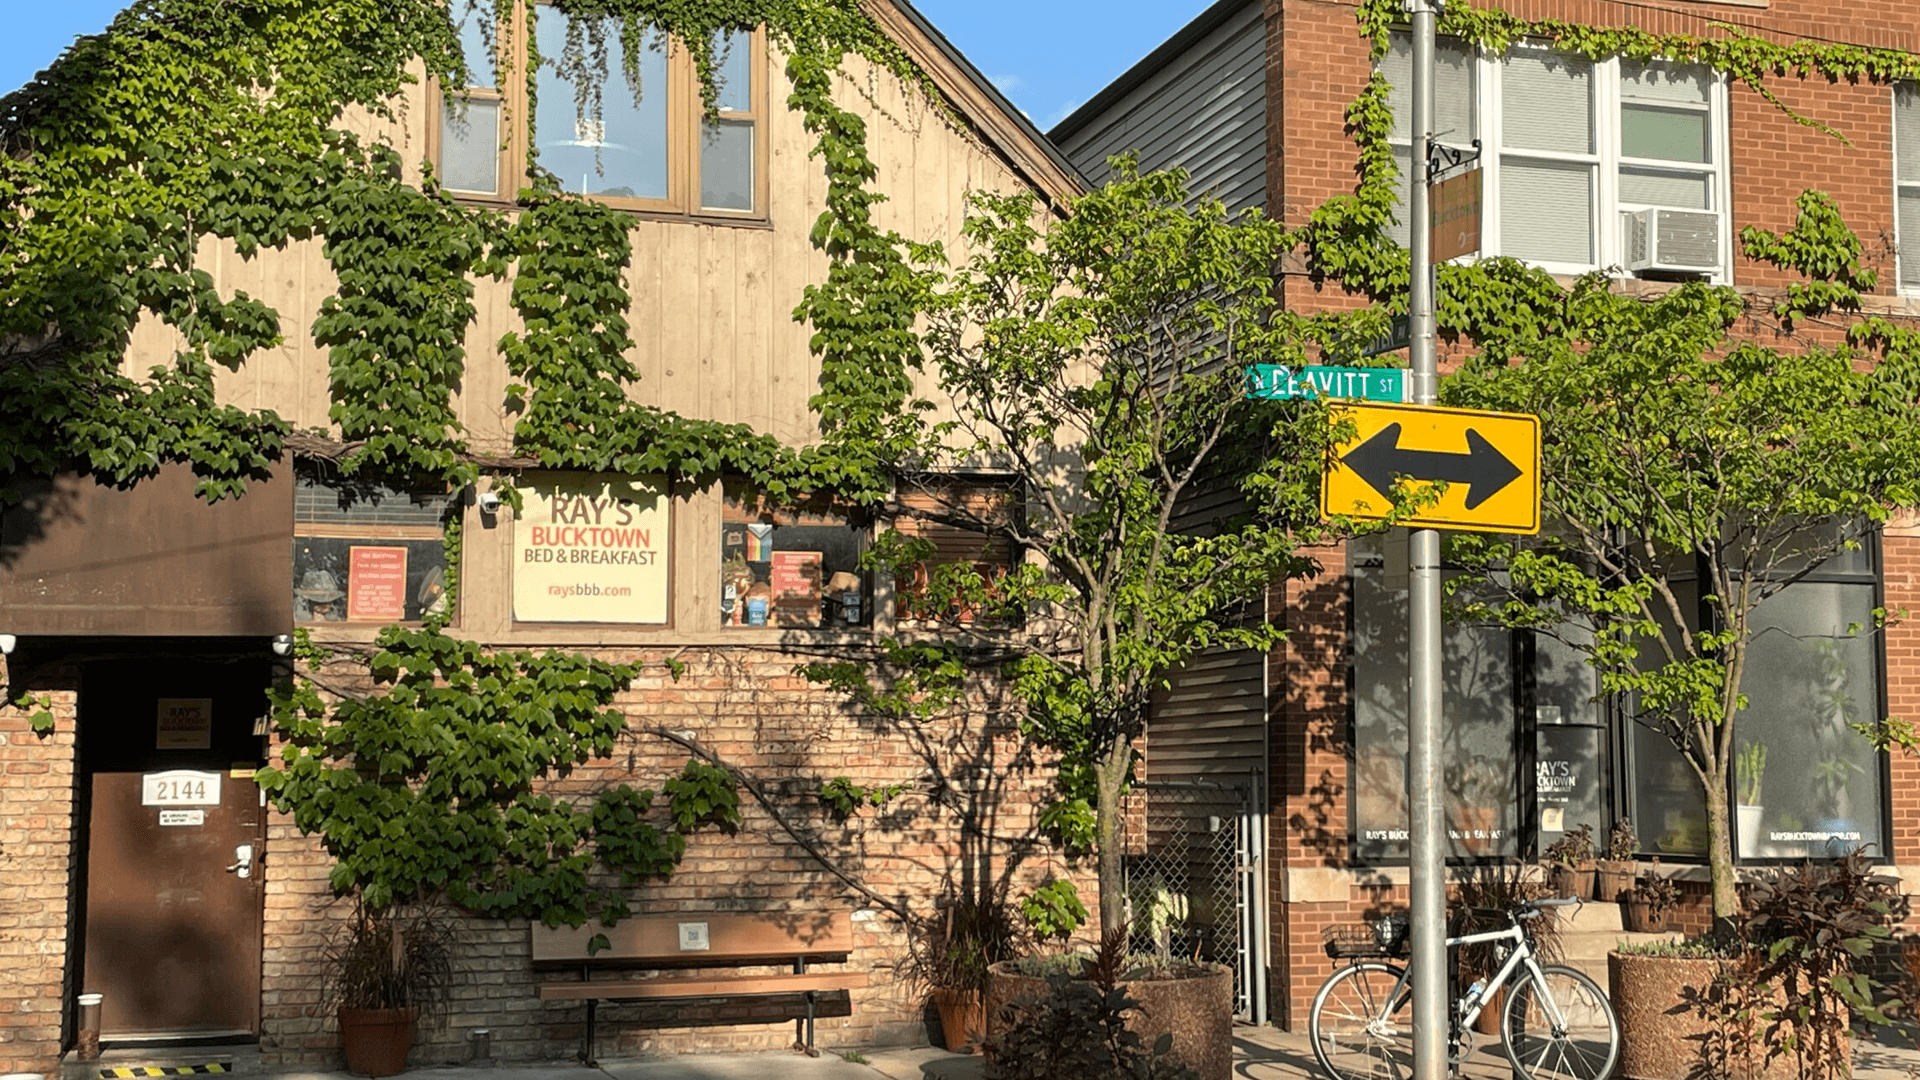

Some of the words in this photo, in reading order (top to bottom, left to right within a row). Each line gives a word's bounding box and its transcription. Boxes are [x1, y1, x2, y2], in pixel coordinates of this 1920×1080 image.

[1272, 368, 1371, 398] LEAVITT
[1379, 378, 1394, 393] ST
[551, 496, 633, 526] RAY'S
[531, 525, 650, 548] BUCKTOWN
[524, 548, 554, 563] BED
[556, 549, 568, 564] &
[570, 549, 657, 566] BREAKFAST
[548, 582, 632, 599] raysbbb.com
[157, 780, 206, 800] 2144
[1536, 775, 1576, 787] CKTOWN
[1365, 830, 1387, 841] RAY'S
[1388, 830, 1409, 841] BUCK
